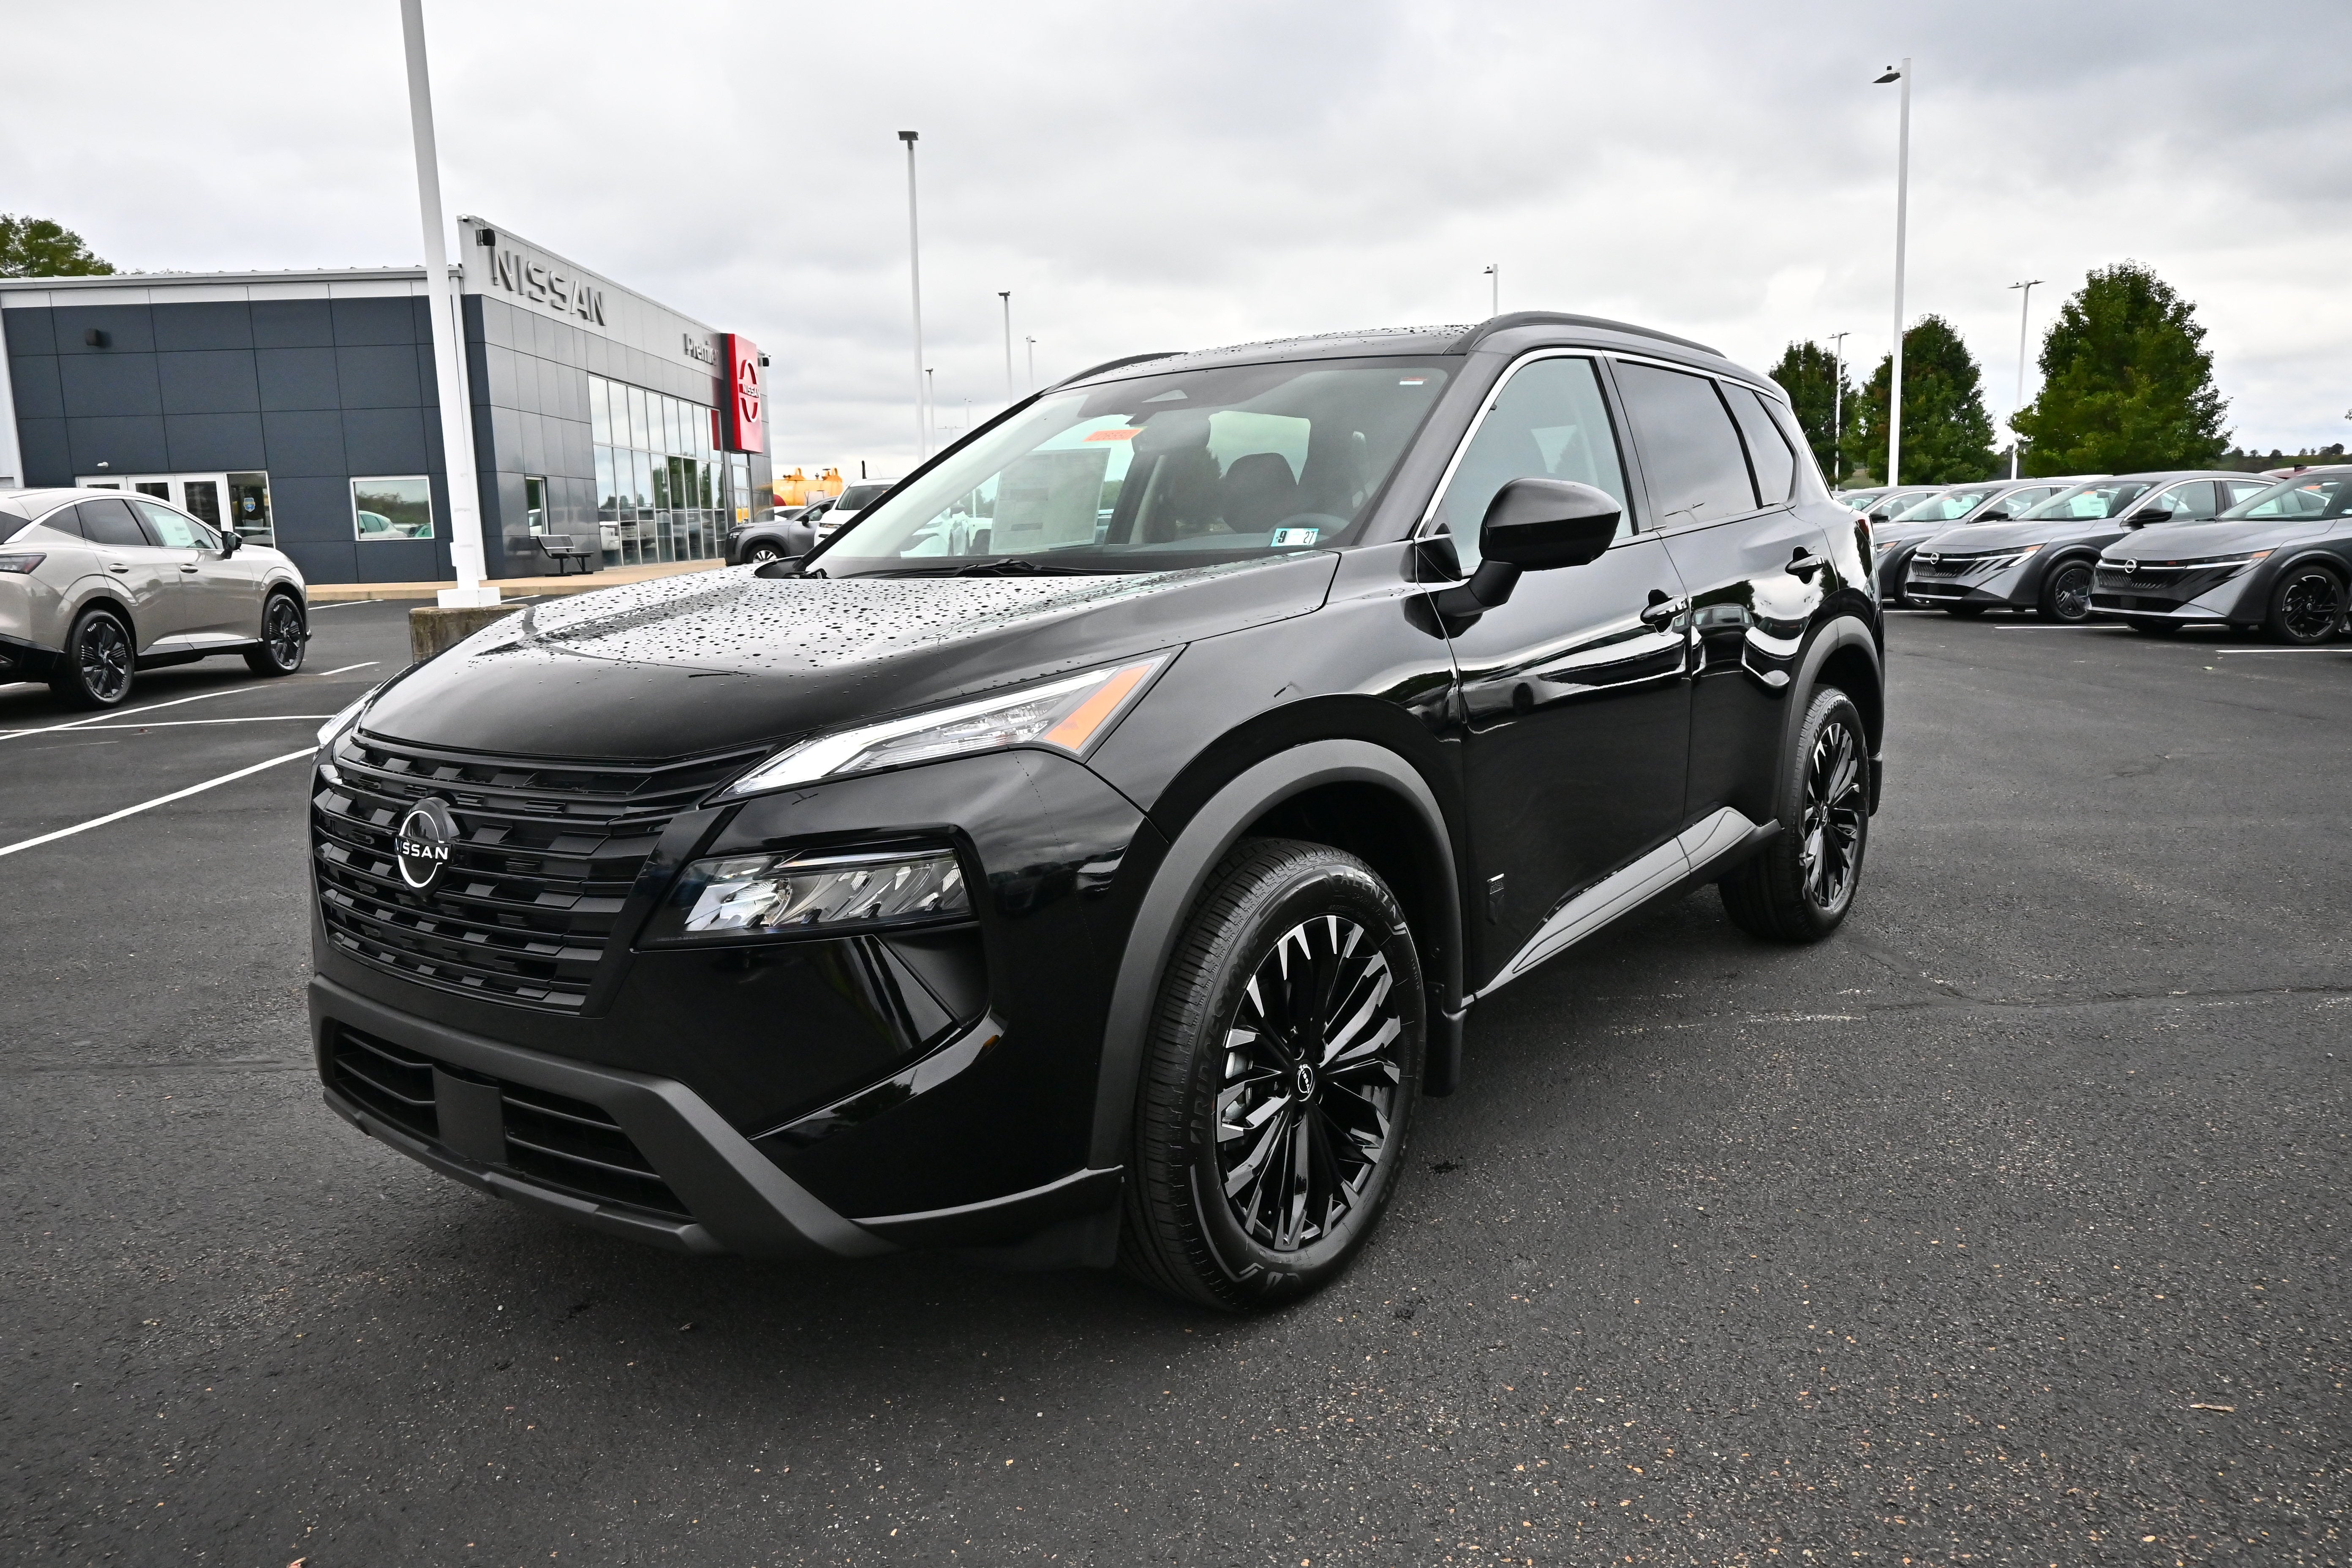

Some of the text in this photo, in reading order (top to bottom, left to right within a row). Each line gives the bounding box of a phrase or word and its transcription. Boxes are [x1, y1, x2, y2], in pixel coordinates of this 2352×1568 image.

[490, 246, 606, 326] NISSAN
[743, 384, 760, 398] NISSAN
[1278, 531, 1315, 544] 9 27
[1340, 869, 1396, 919] ALENZA
